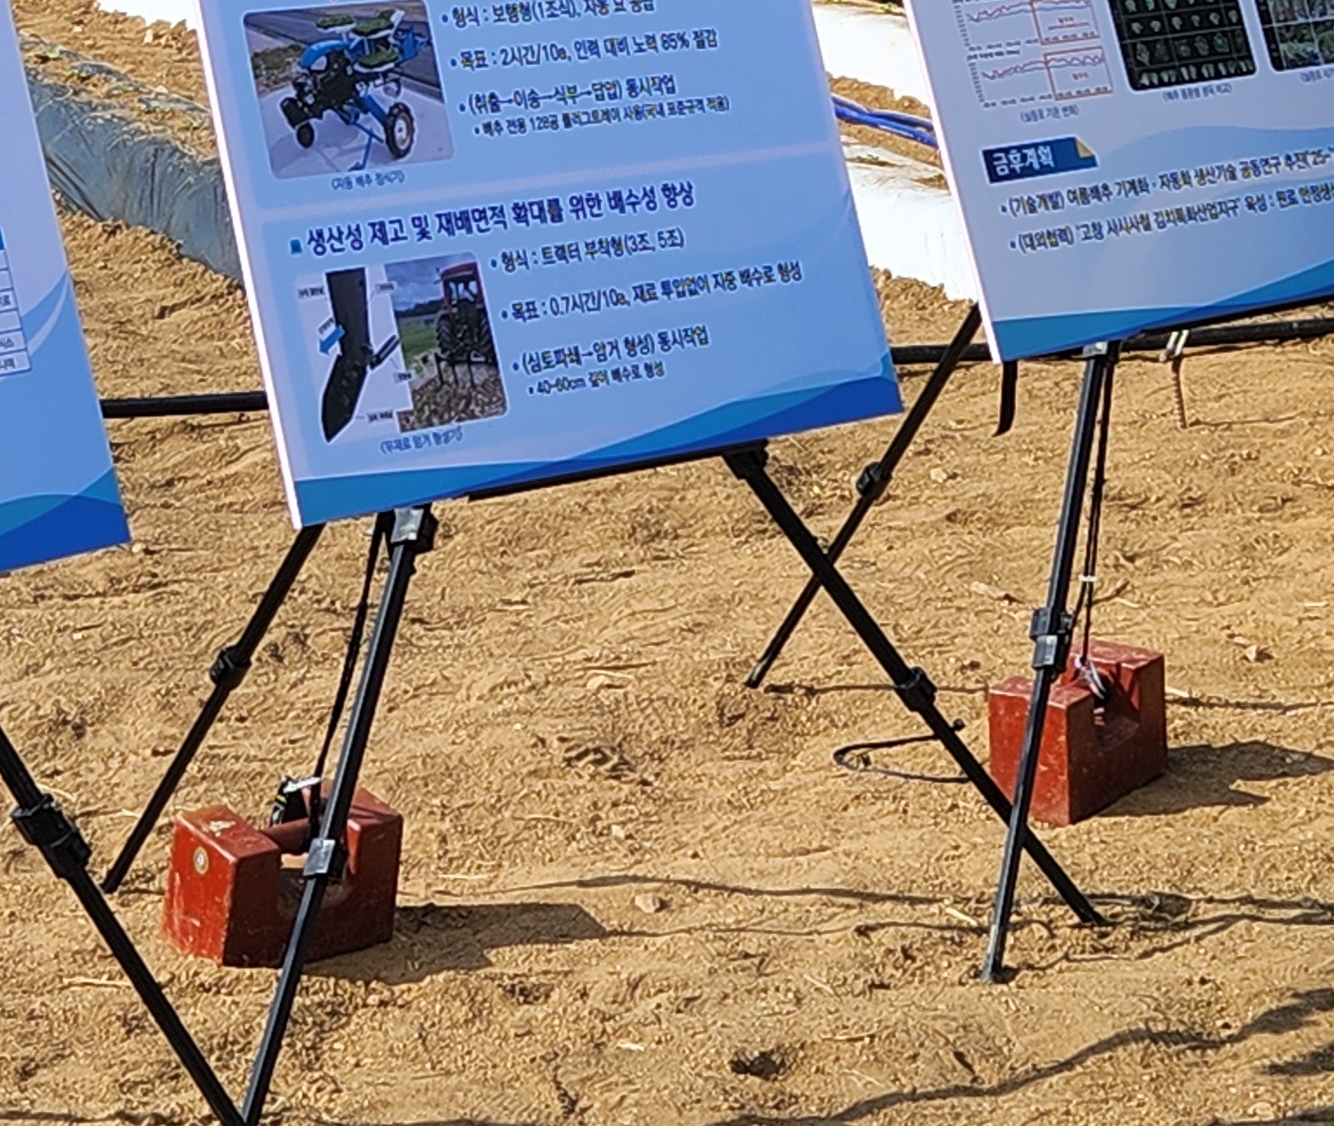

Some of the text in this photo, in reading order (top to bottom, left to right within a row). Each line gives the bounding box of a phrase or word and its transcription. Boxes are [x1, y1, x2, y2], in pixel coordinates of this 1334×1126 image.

[573, 39, 601, 61] 인력
[991, 146, 1055, 176] 금후계획
[306, 180, 695, 258] 생산성 제고 및 재배면적 확대를 위한 배수성 향상
